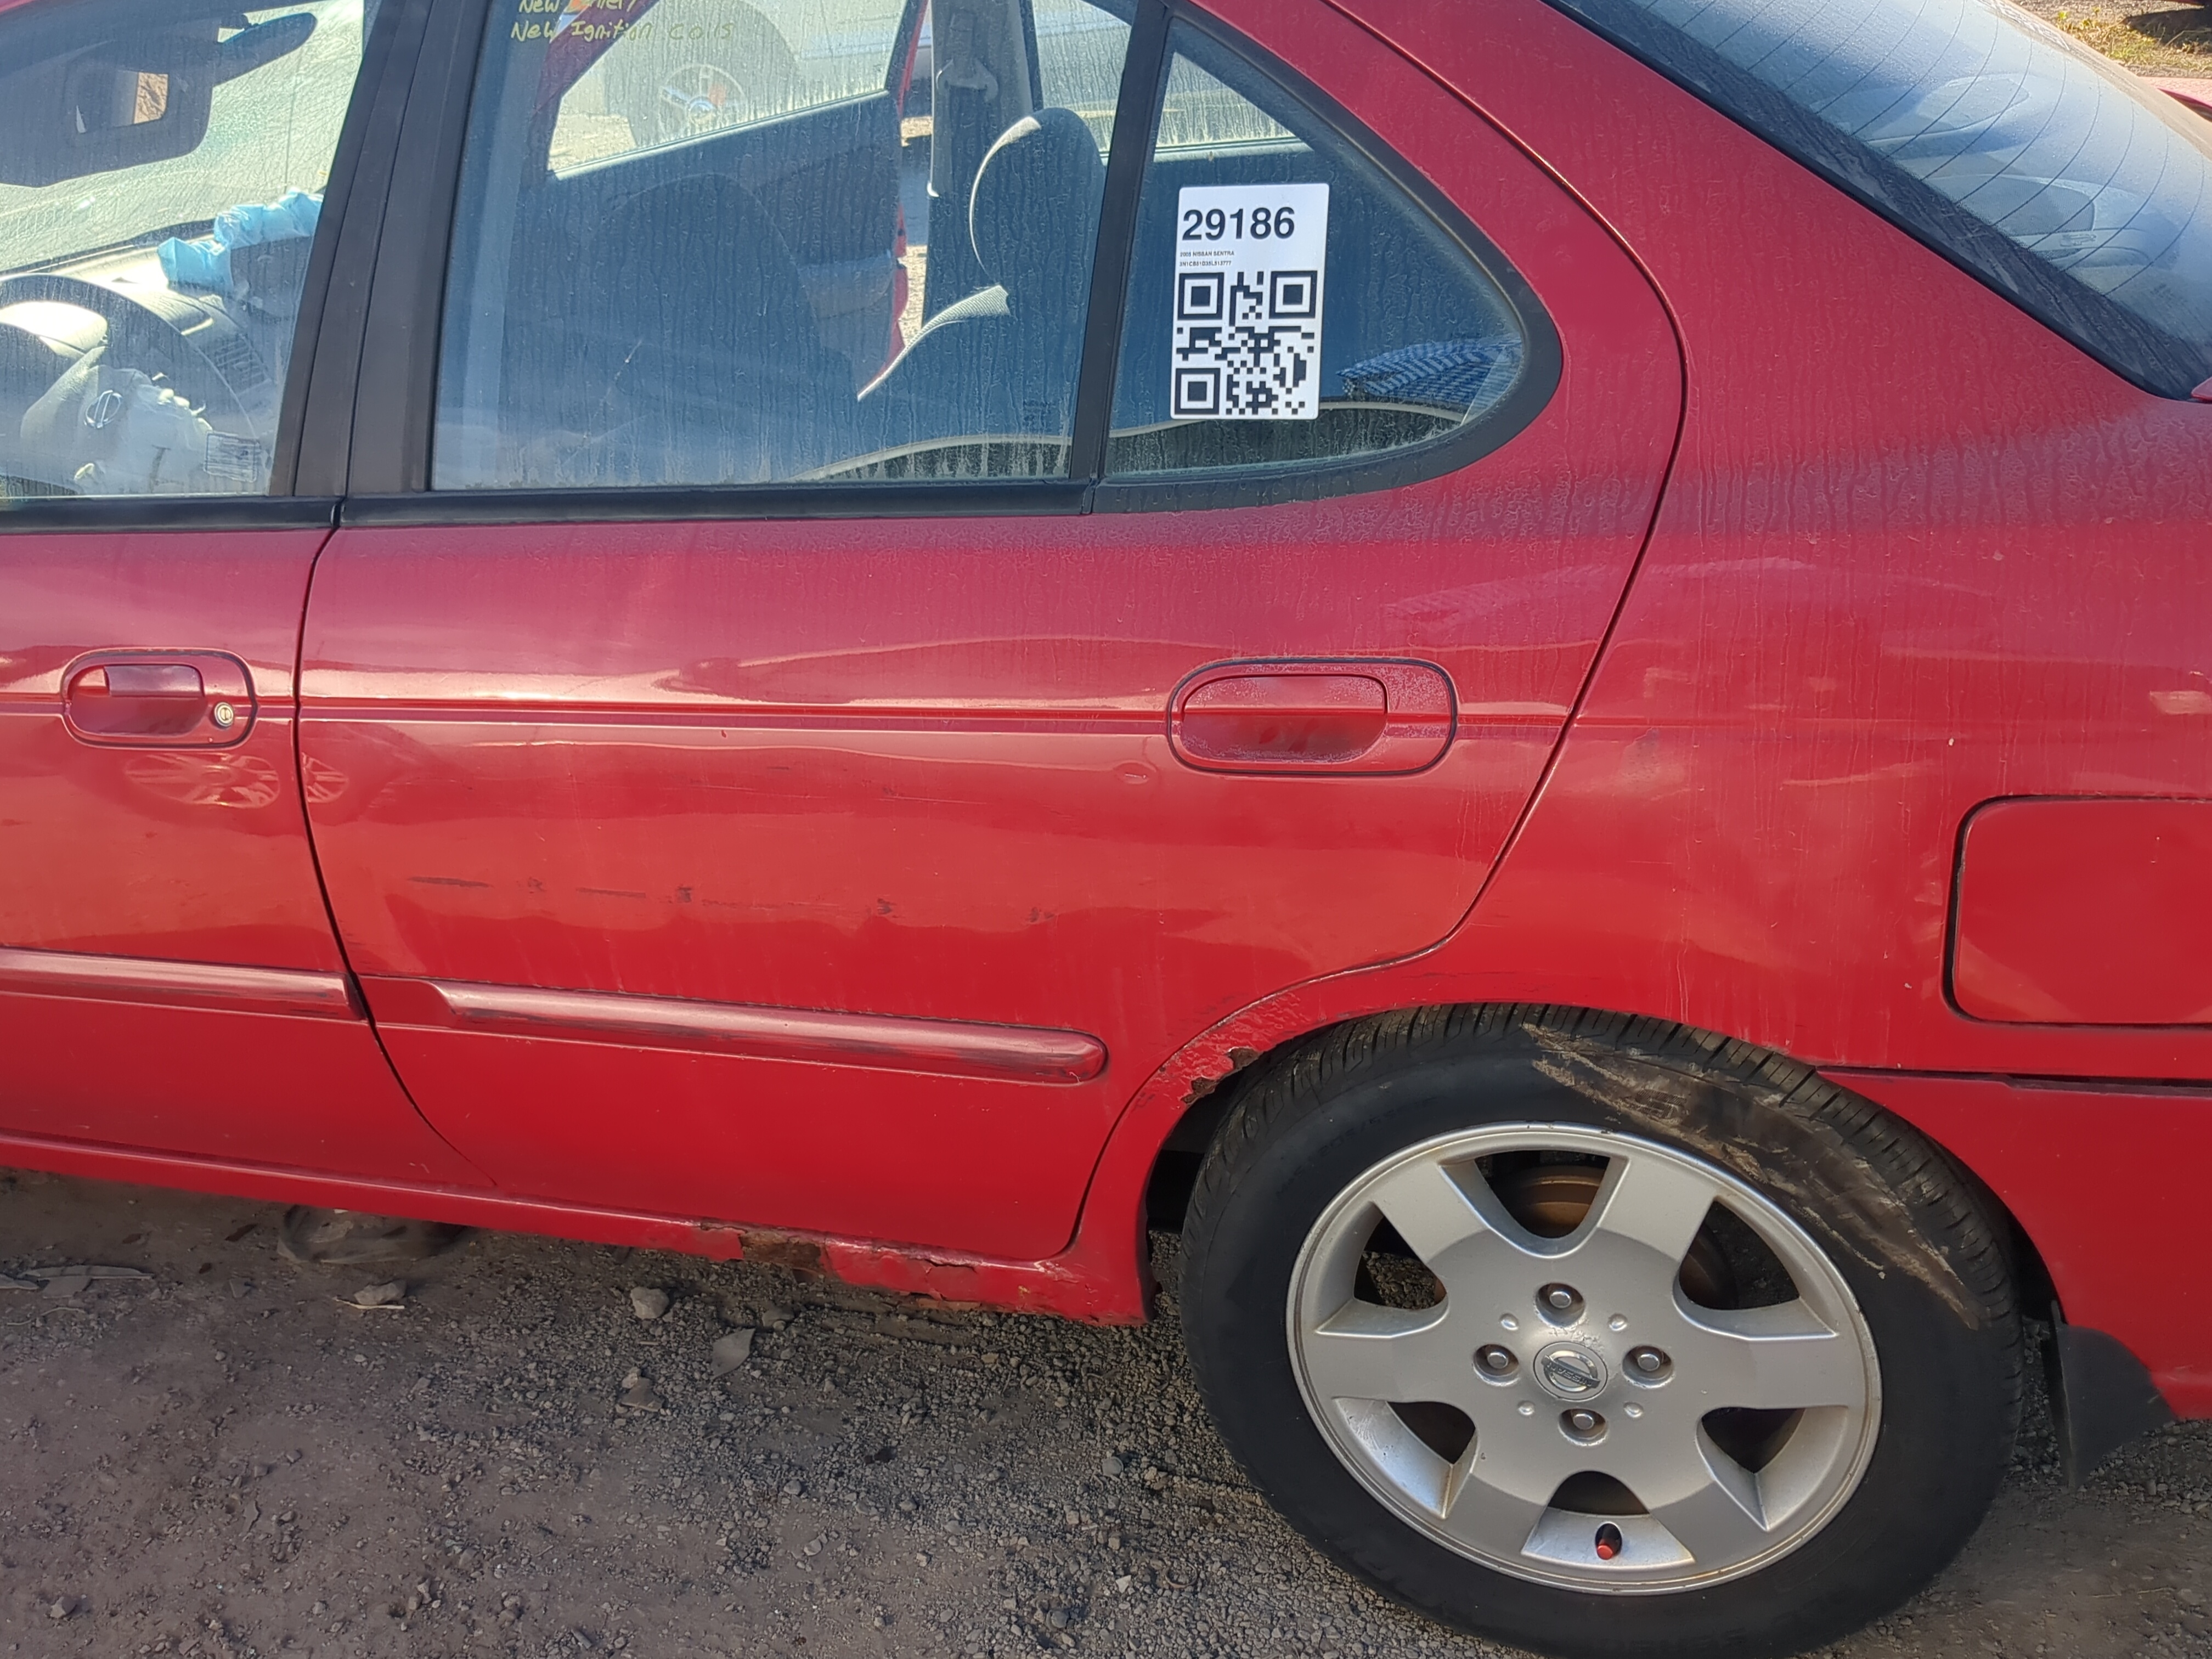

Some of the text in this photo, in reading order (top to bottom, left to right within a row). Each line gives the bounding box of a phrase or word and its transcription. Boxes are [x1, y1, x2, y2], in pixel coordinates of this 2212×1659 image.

[518, 0, 559, 13] New
[510, 20, 559, 42] New
[570, 19, 652, 42] Ignition
[1182, 207, 1295, 241] 29186
